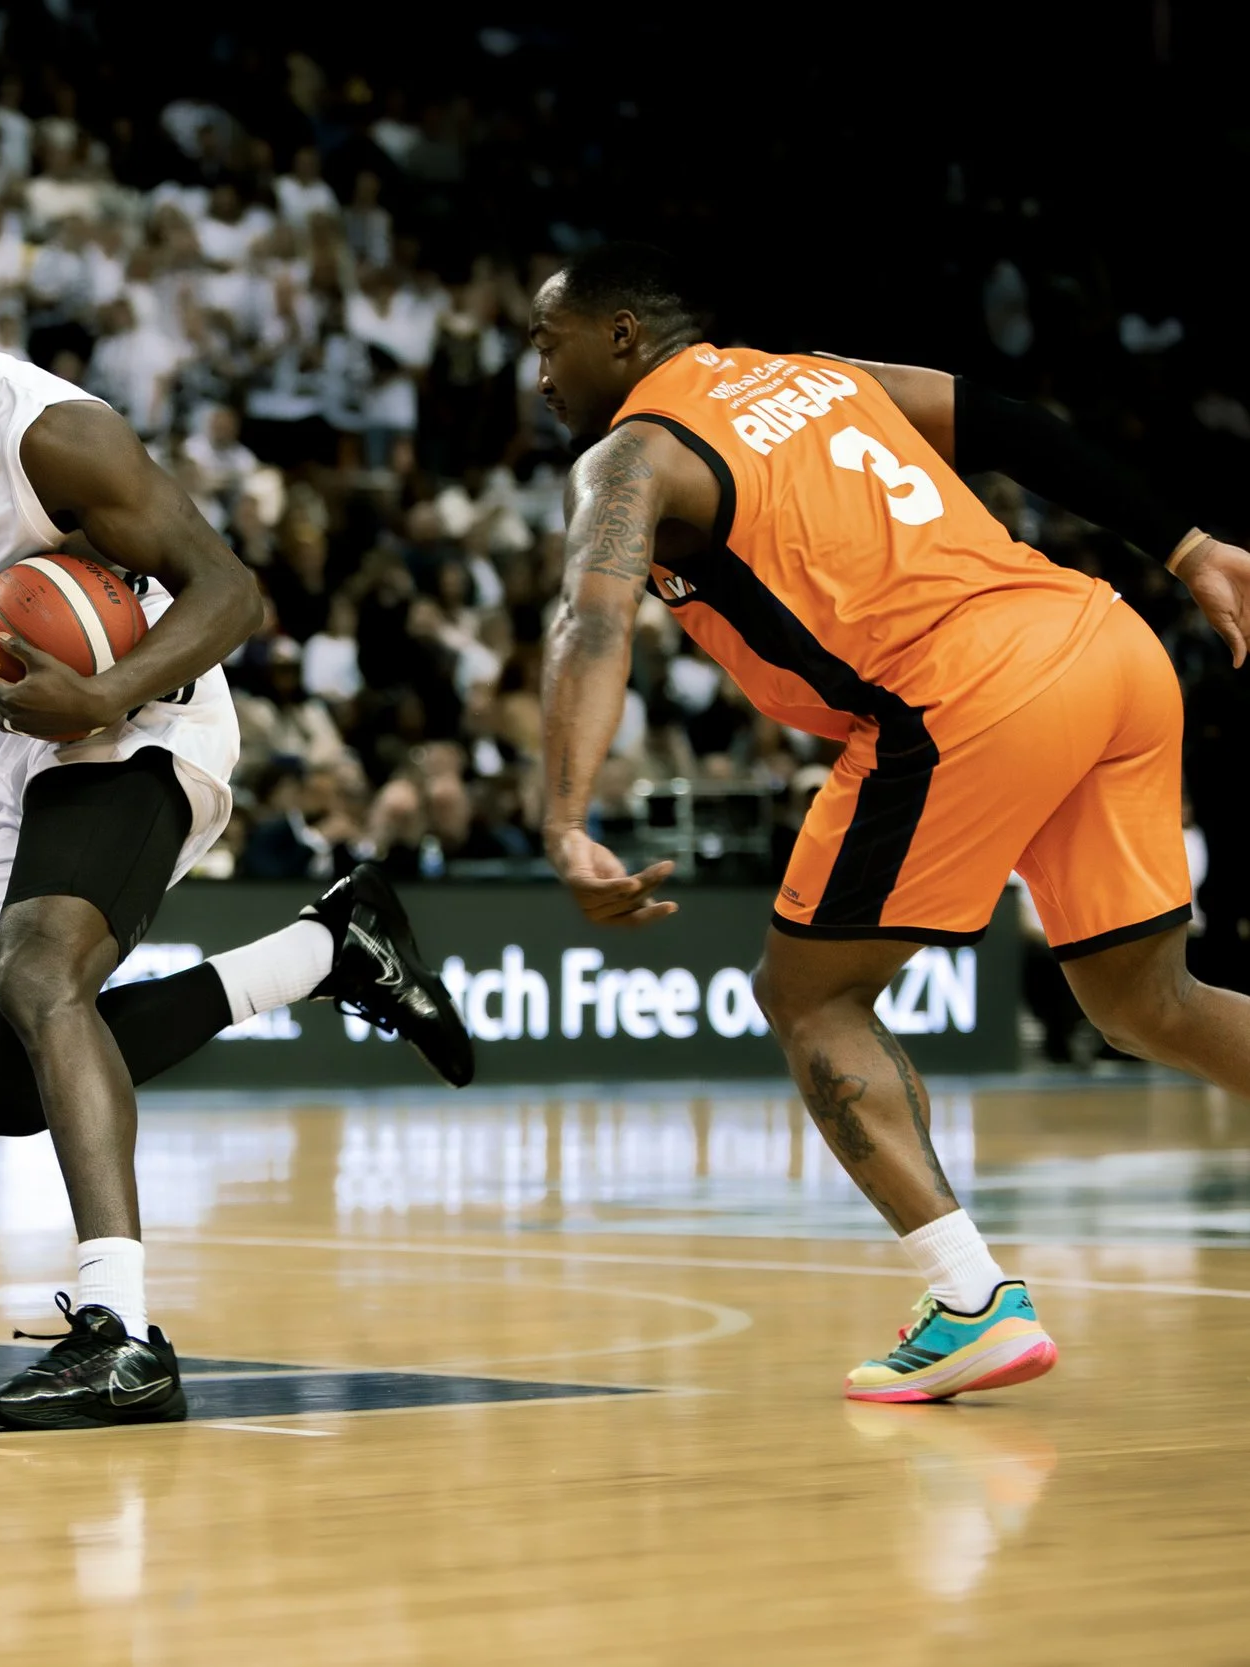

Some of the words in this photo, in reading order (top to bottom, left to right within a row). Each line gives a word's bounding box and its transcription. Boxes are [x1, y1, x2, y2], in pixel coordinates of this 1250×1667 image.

[731, 368, 858, 456] RIDEAU
[830, 425, 944, 526] 3
[560, 947, 700, 1040] Free
[873, 945, 977, 1034] ZN
